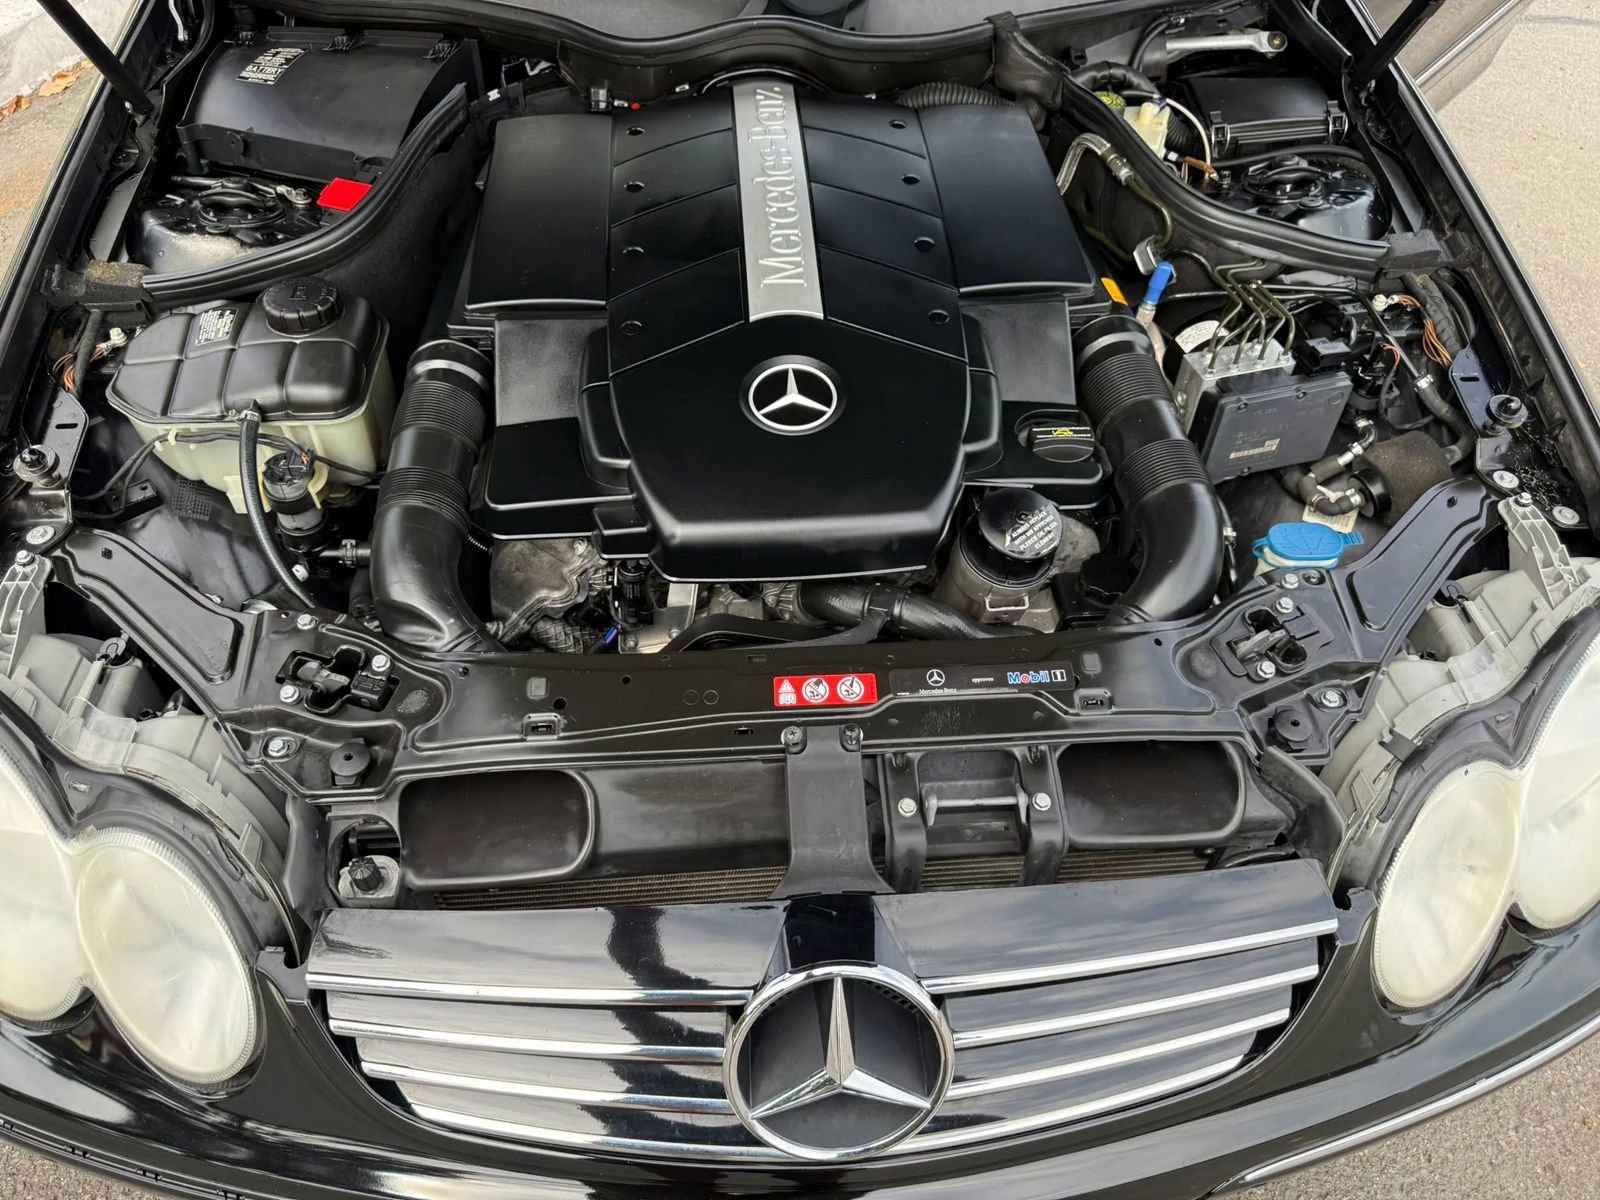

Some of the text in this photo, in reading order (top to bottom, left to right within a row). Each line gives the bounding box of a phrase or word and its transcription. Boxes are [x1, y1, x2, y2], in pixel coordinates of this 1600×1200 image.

[245, 65, 285, 74] BATTERY
[749, 86, 808, 289] Mercedes-Benz
[1007, 671, 1050, 684] Mobil
[1051, 669, 1067, 682] 1
